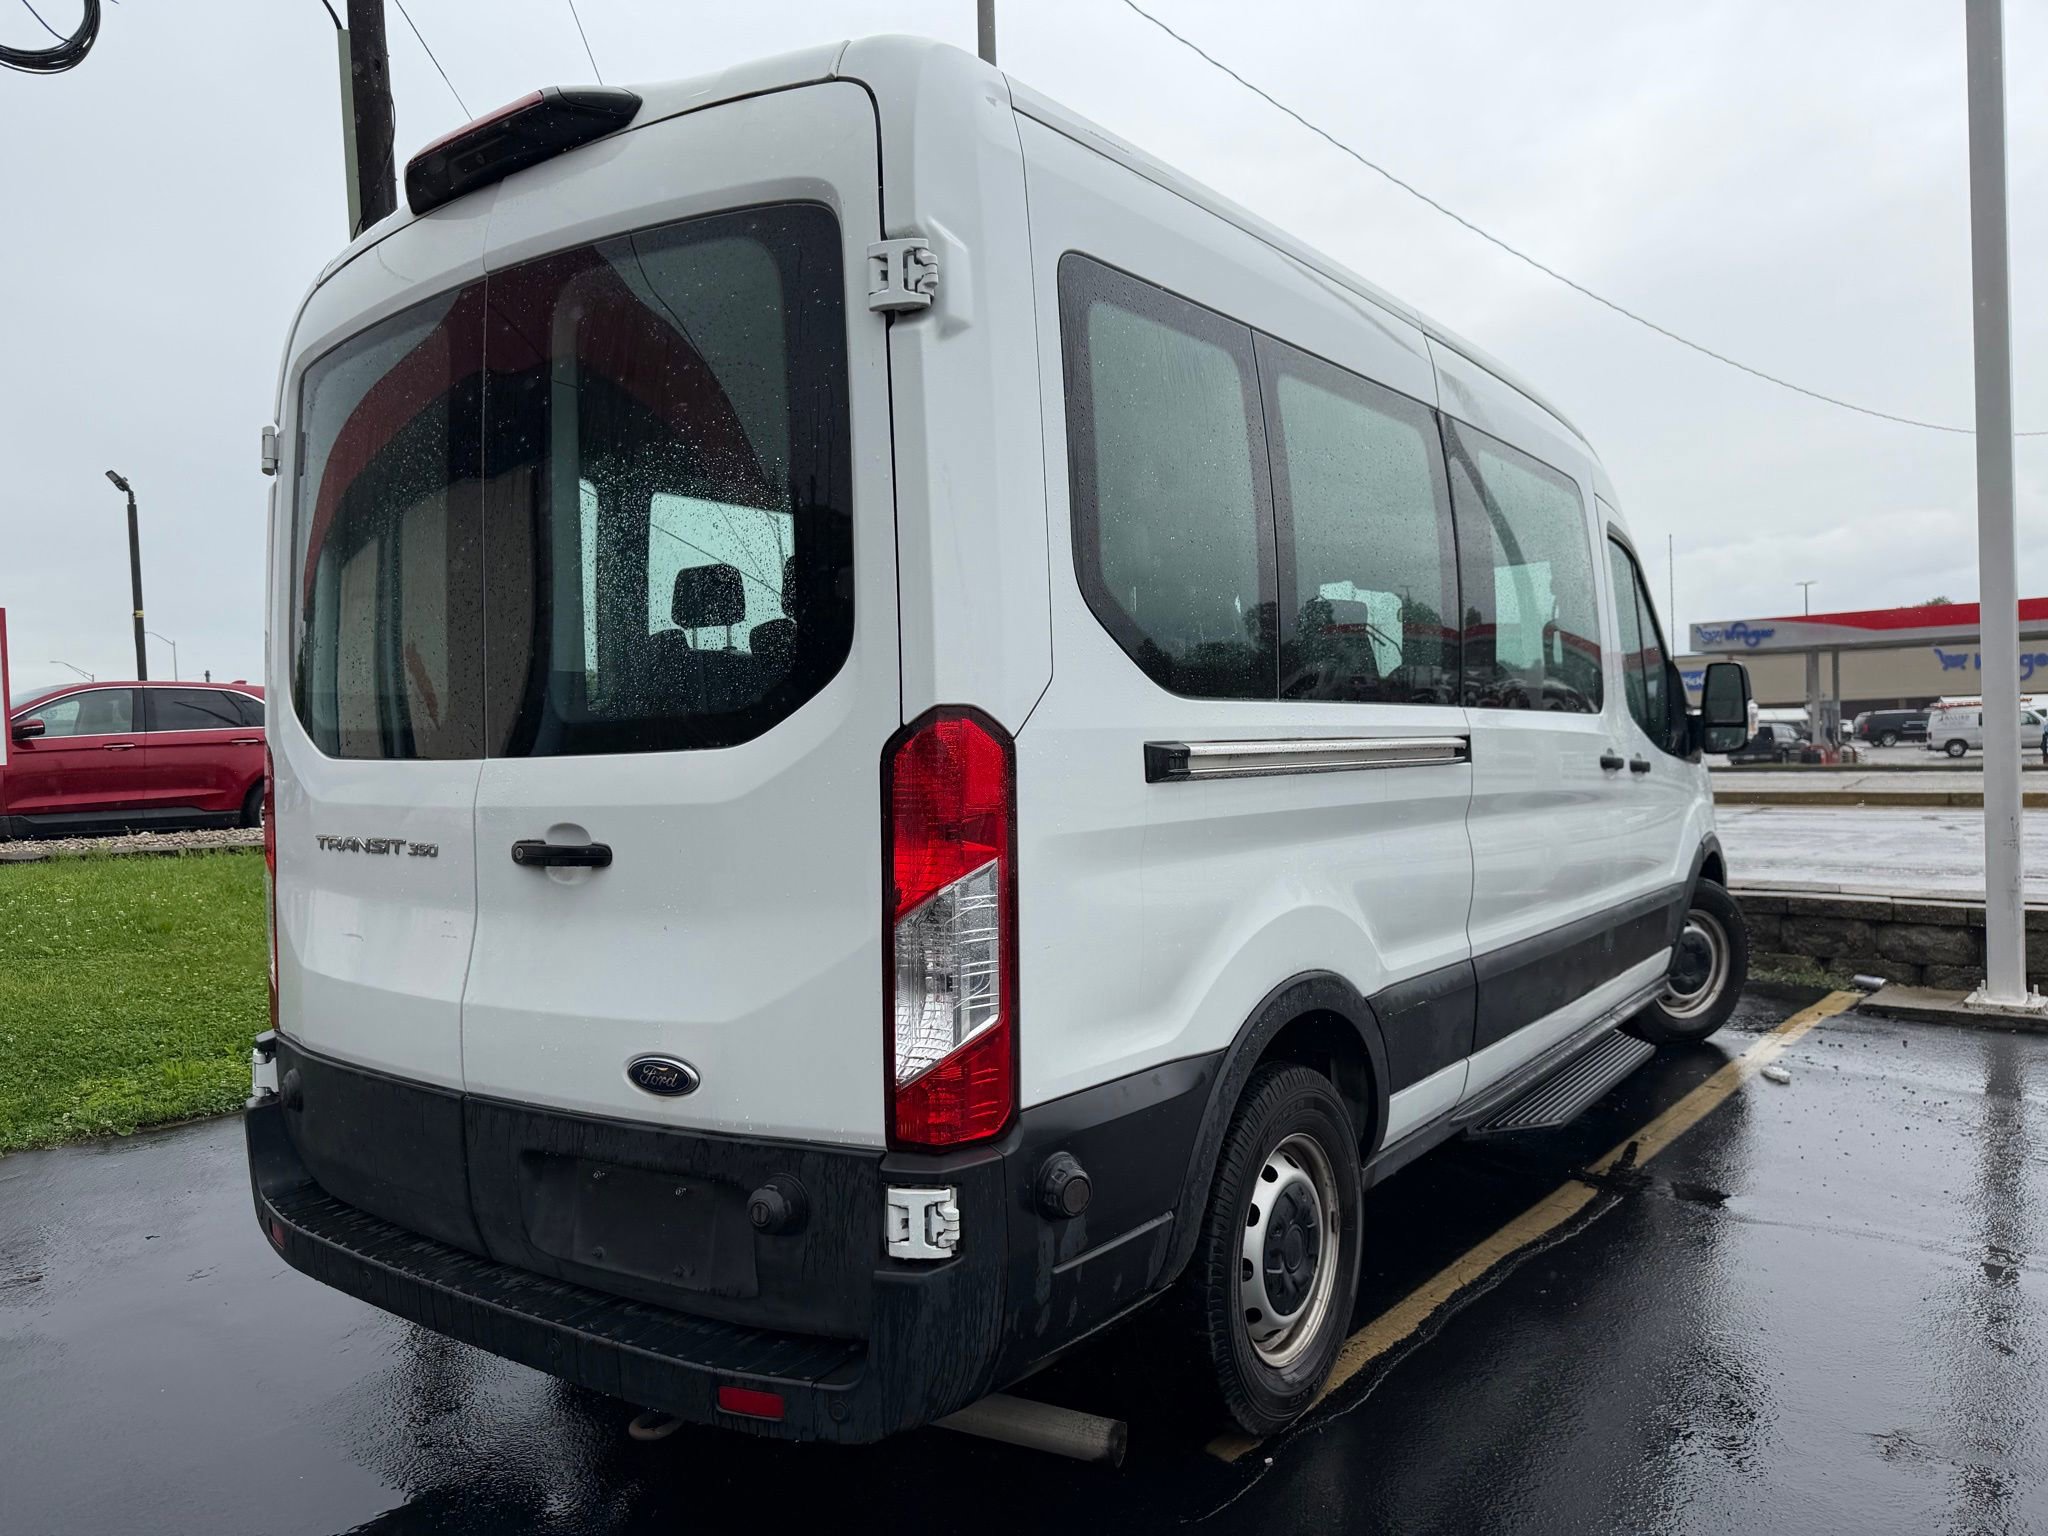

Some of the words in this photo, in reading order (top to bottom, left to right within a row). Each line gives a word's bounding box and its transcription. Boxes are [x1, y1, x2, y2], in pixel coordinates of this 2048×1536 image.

[315, 835, 406, 855] TRANSIT
[407, 842, 439, 858] 350
[640, 1064, 678, 1088] Ford
